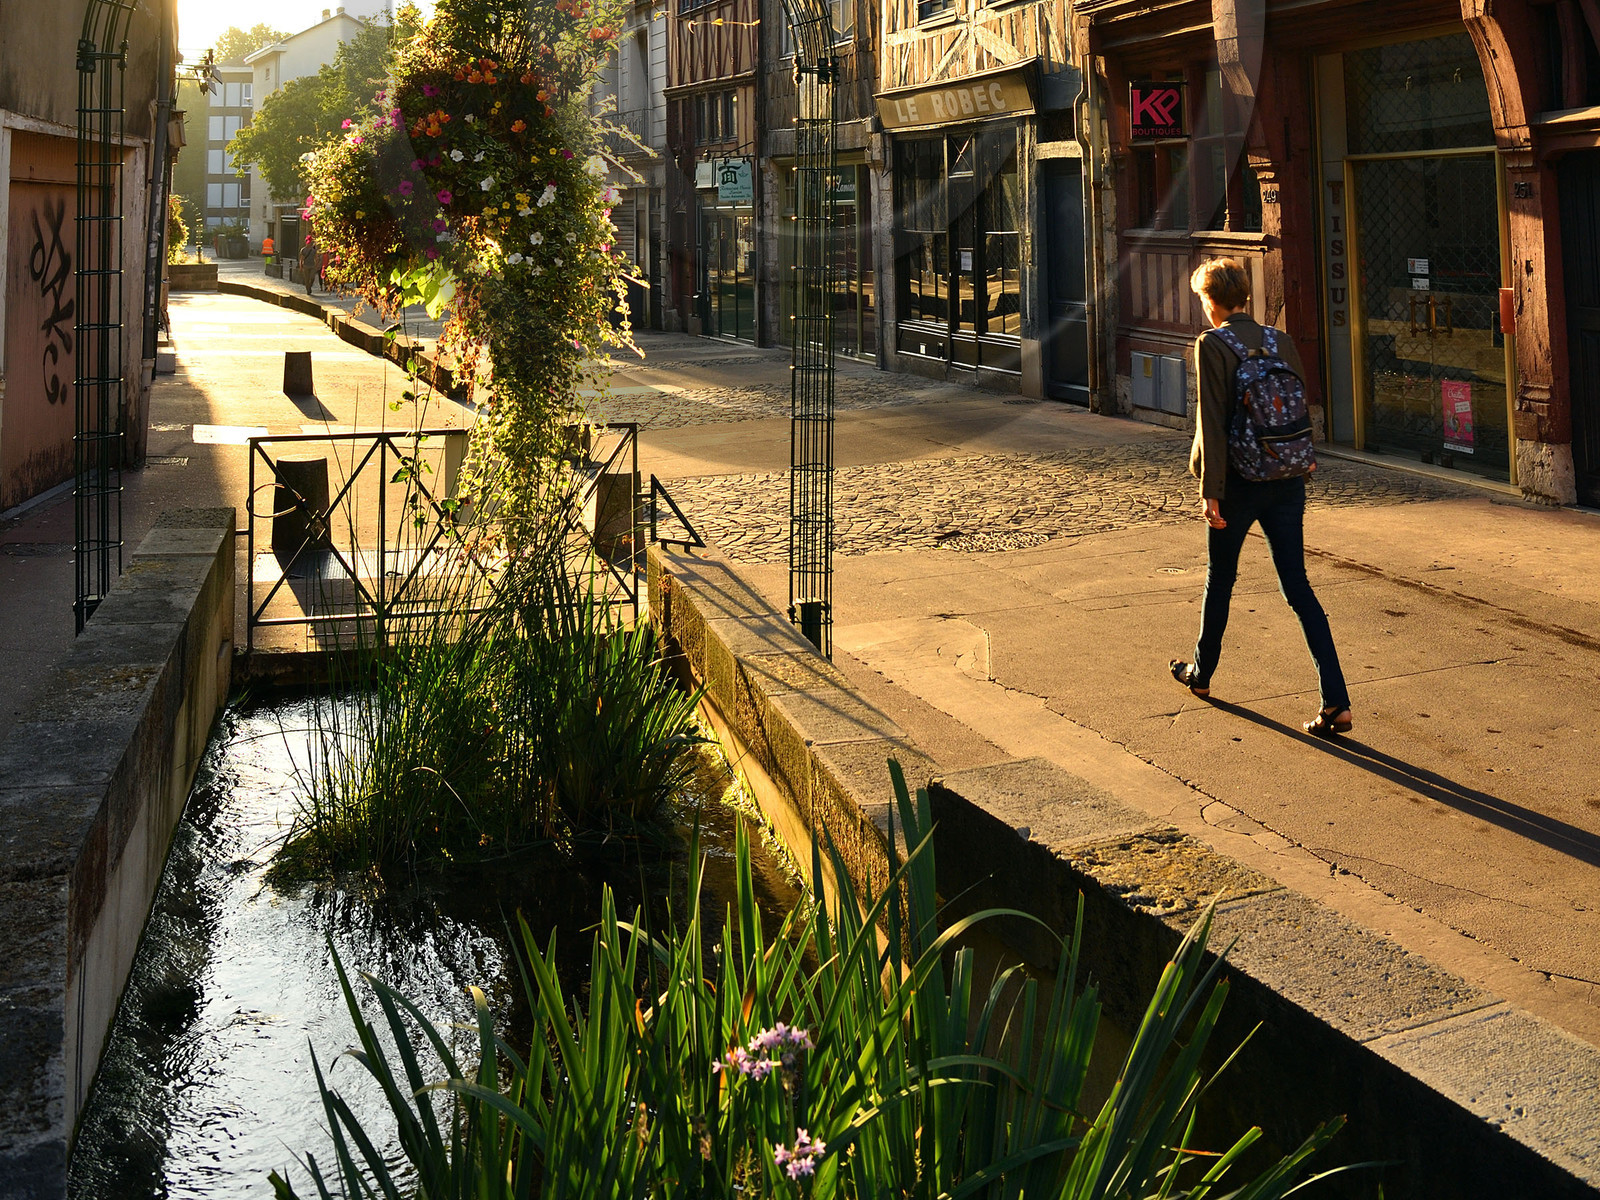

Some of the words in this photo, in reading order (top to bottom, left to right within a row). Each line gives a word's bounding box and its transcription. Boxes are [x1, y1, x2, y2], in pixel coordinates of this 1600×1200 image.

[894, 98, 919, 123] LE
[930, 82, 1007, 119] ROBEC
[1132, 127, 1182, 136] BOUTIQUES
[1262, 189, 1277, 203] 249
[1514, 181, 1534, 199] 251
[1327, 180, 1346, 327] TISSUS
